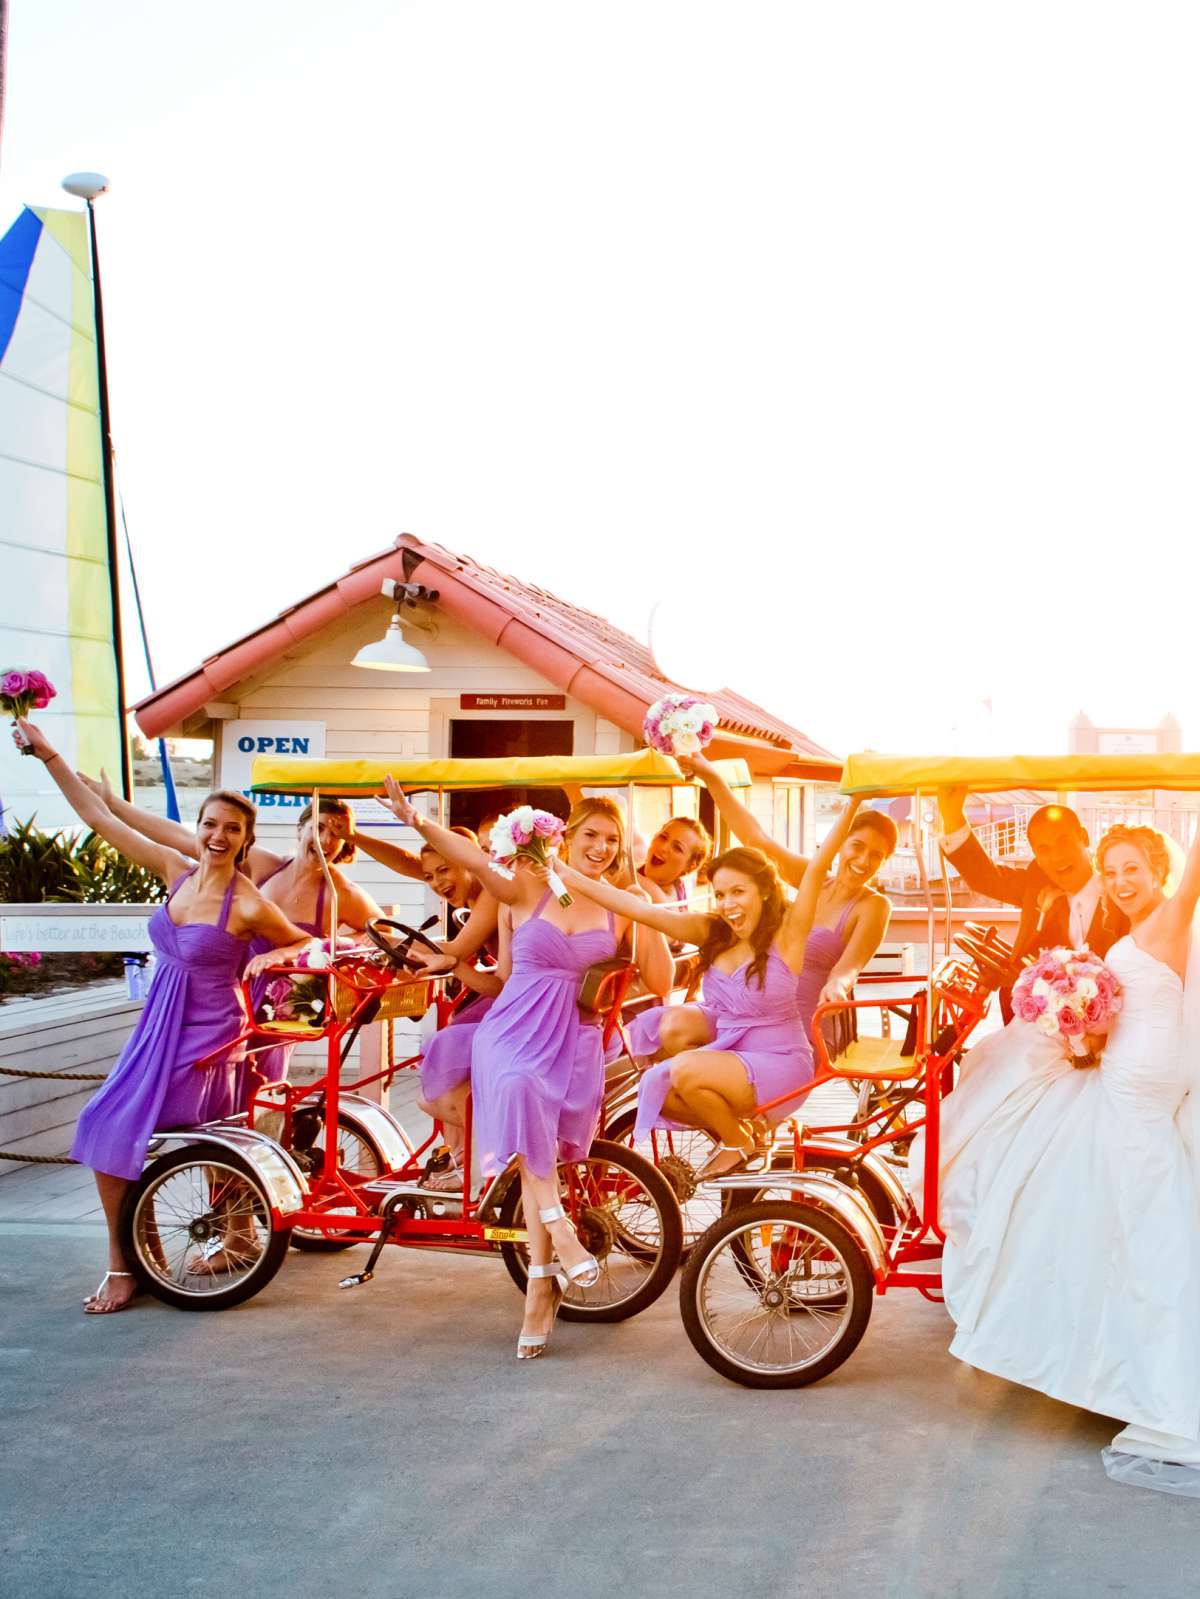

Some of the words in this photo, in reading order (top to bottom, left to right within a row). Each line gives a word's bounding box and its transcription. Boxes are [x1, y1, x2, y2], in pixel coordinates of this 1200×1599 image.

[238, 736, 309, 754] OPEN
[239, 790, 311, 807] UBLI
[35, 922, 70, 941] better
[71, 923, 87, 941] at
[88, 922, 107, 941] the
[110, 922, 147, 941] Beach
